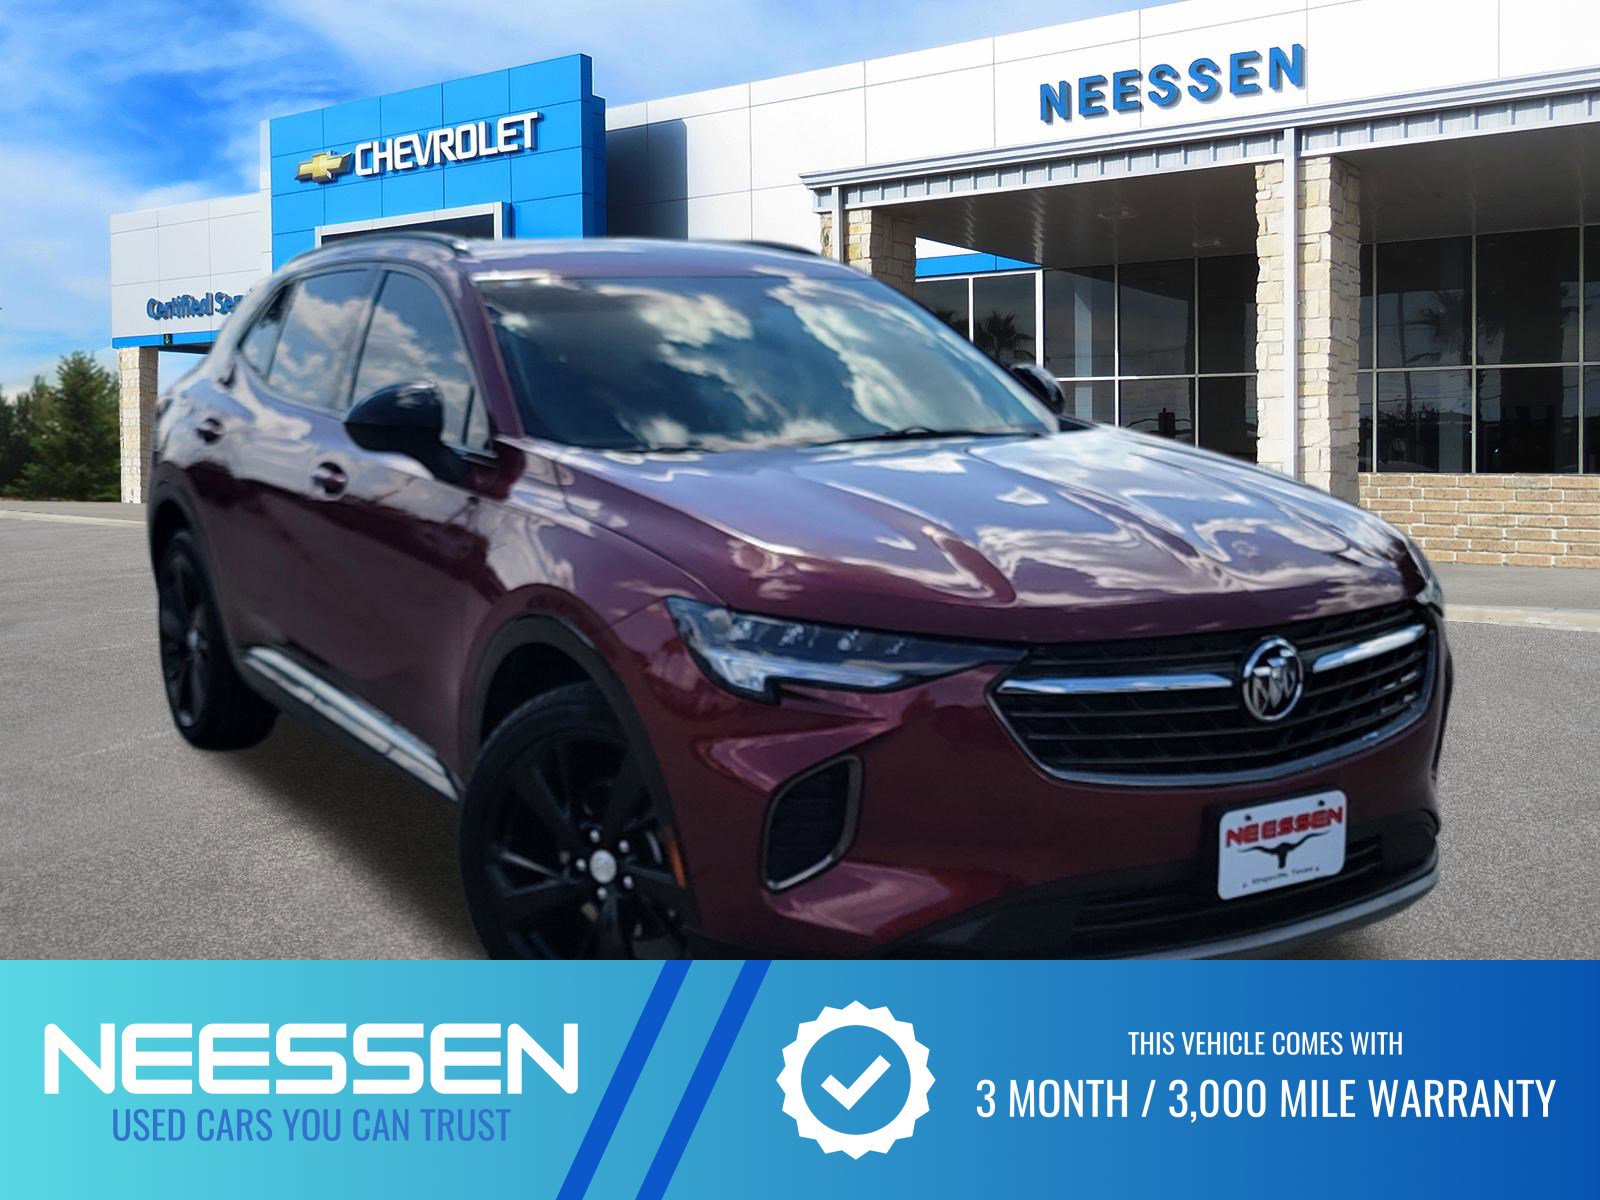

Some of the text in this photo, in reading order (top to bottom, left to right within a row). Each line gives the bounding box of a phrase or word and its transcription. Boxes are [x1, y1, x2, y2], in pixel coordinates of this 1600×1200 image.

[1040, 43, 1306, 125] NEESSEN
[355, 112, 543, 177] CHEVROLET
[147, 292, 214, 320] Certified
[1225, 806, 1343, 848] NEESSEN
